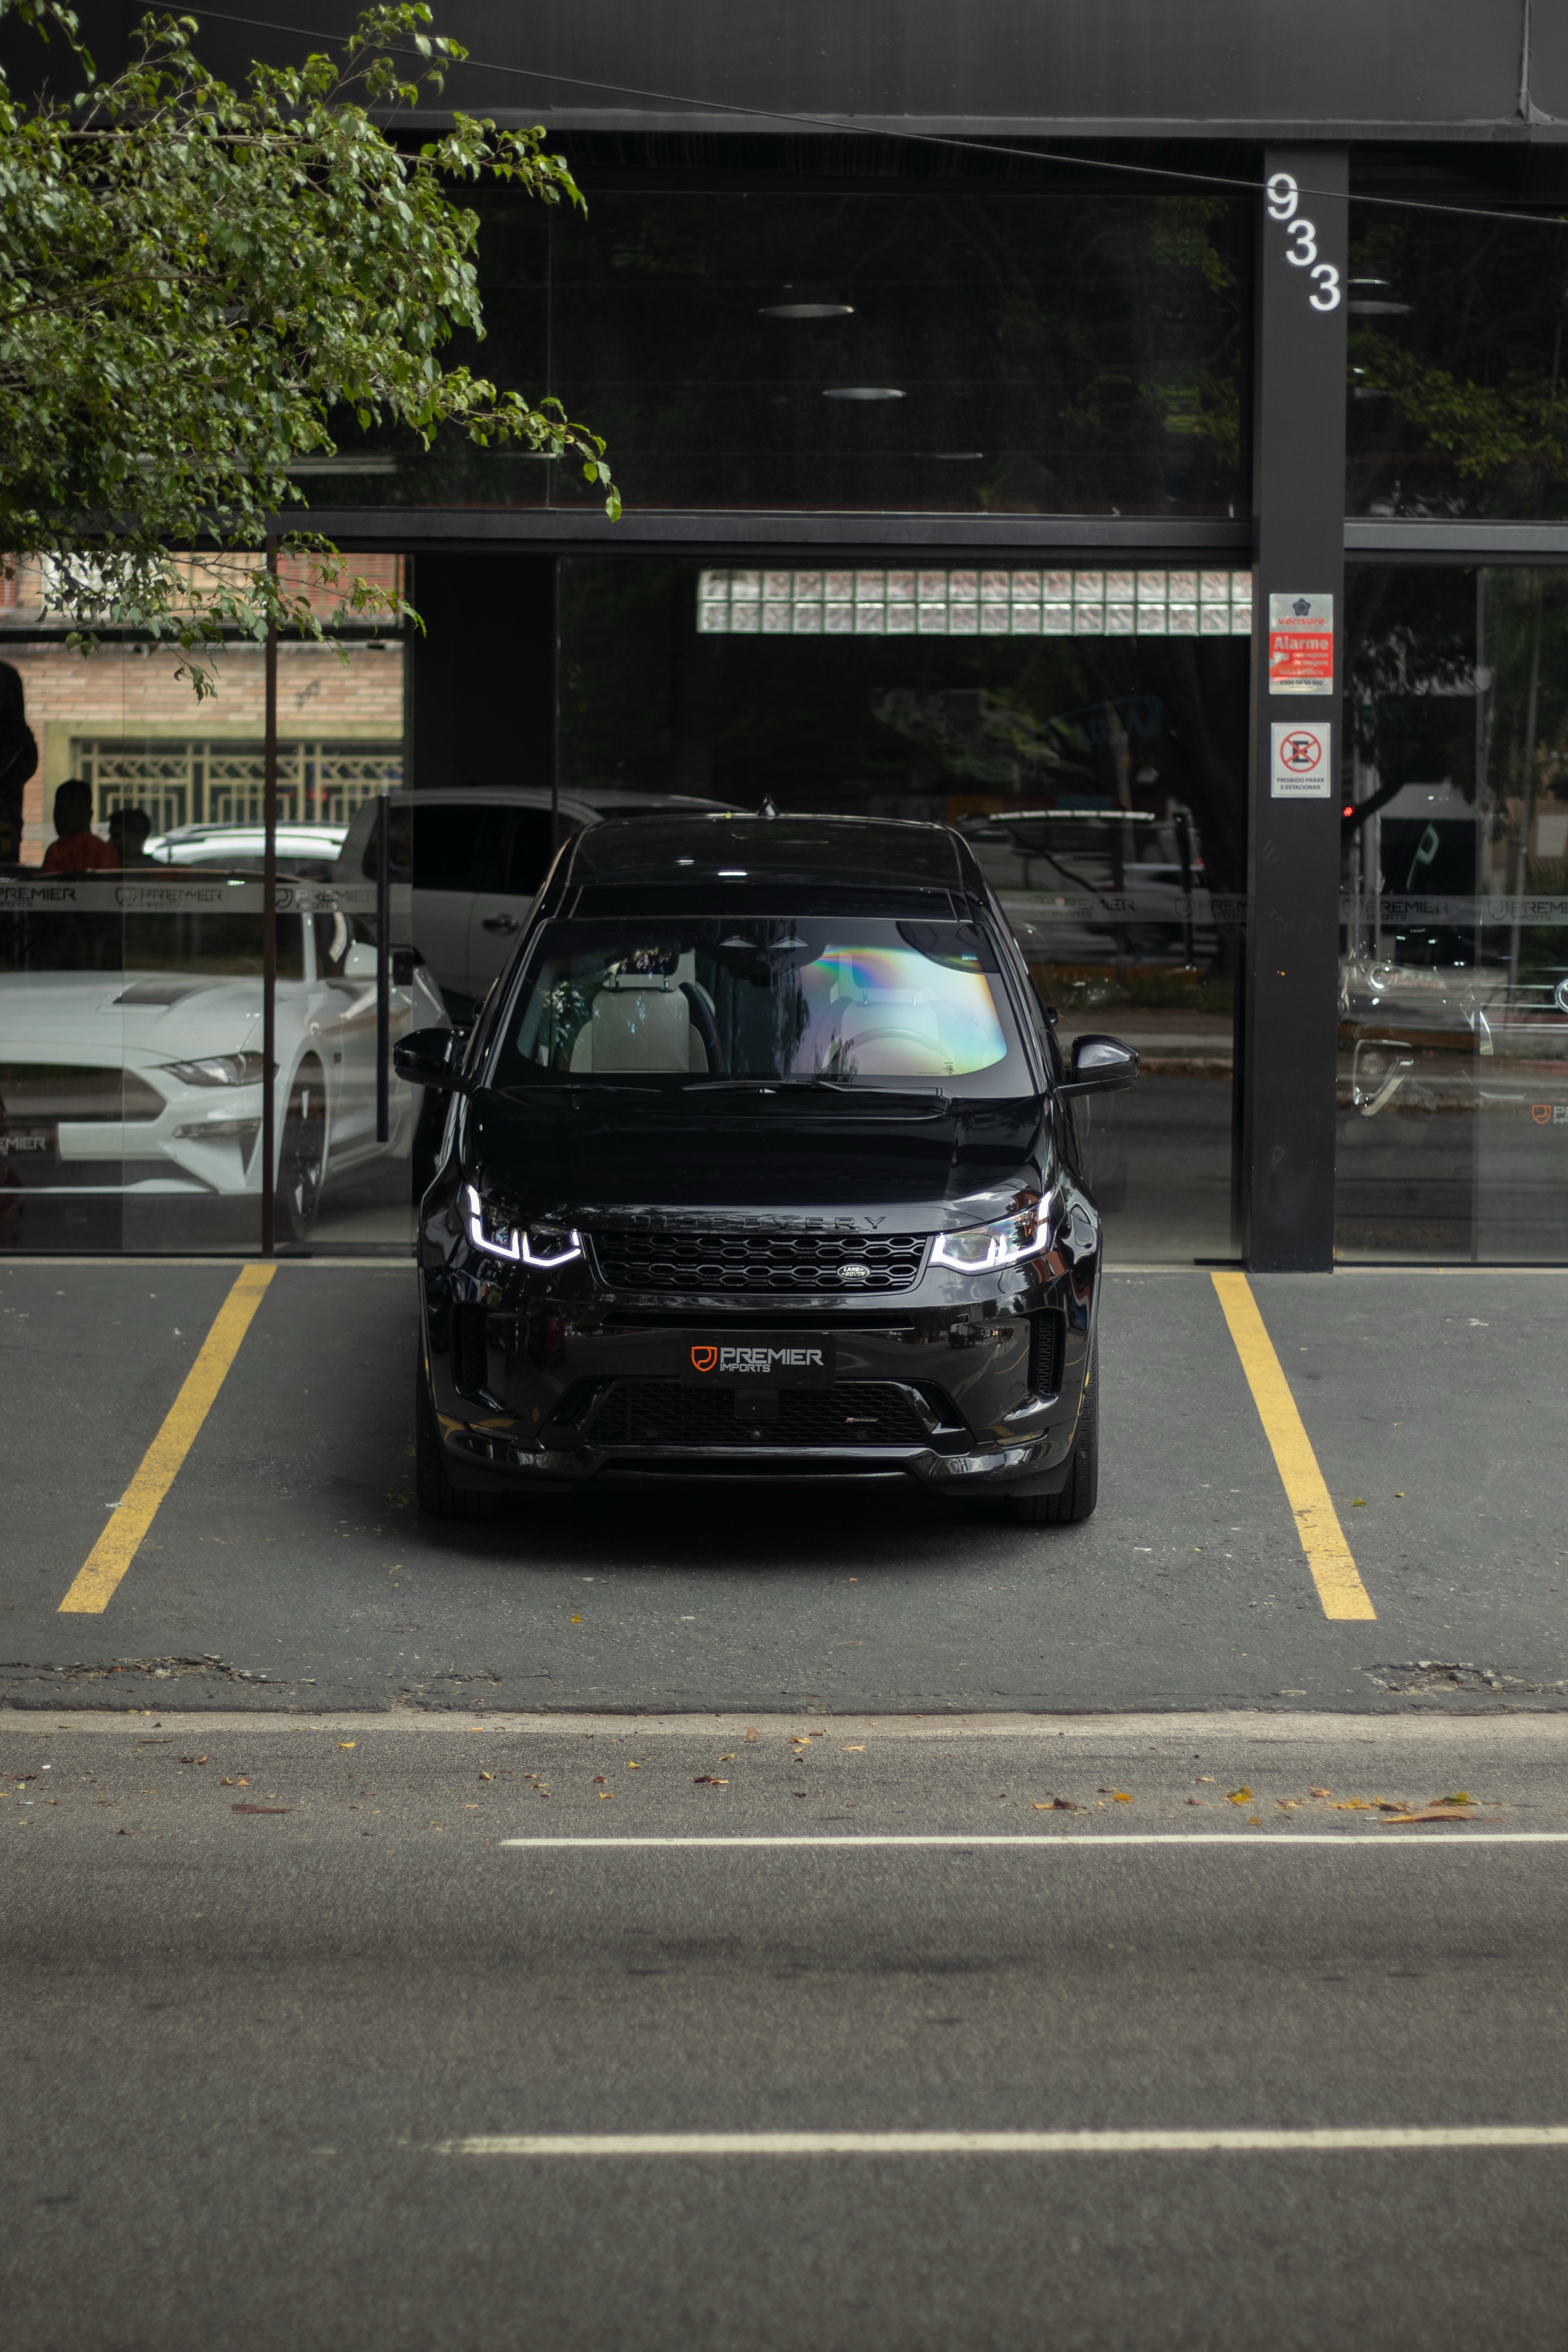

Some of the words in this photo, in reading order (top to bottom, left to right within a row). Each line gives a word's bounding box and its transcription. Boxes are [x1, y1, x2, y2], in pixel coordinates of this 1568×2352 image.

[1266, 173, 1341, 311] 933
[1275, 636, 1329, 650] Alarme
[632, 1214, 886, 1230] DISCOVERY
[720, 1347, 824, 1365] PREMIER
[720, 1363, 770, 1372] IMPORTS
